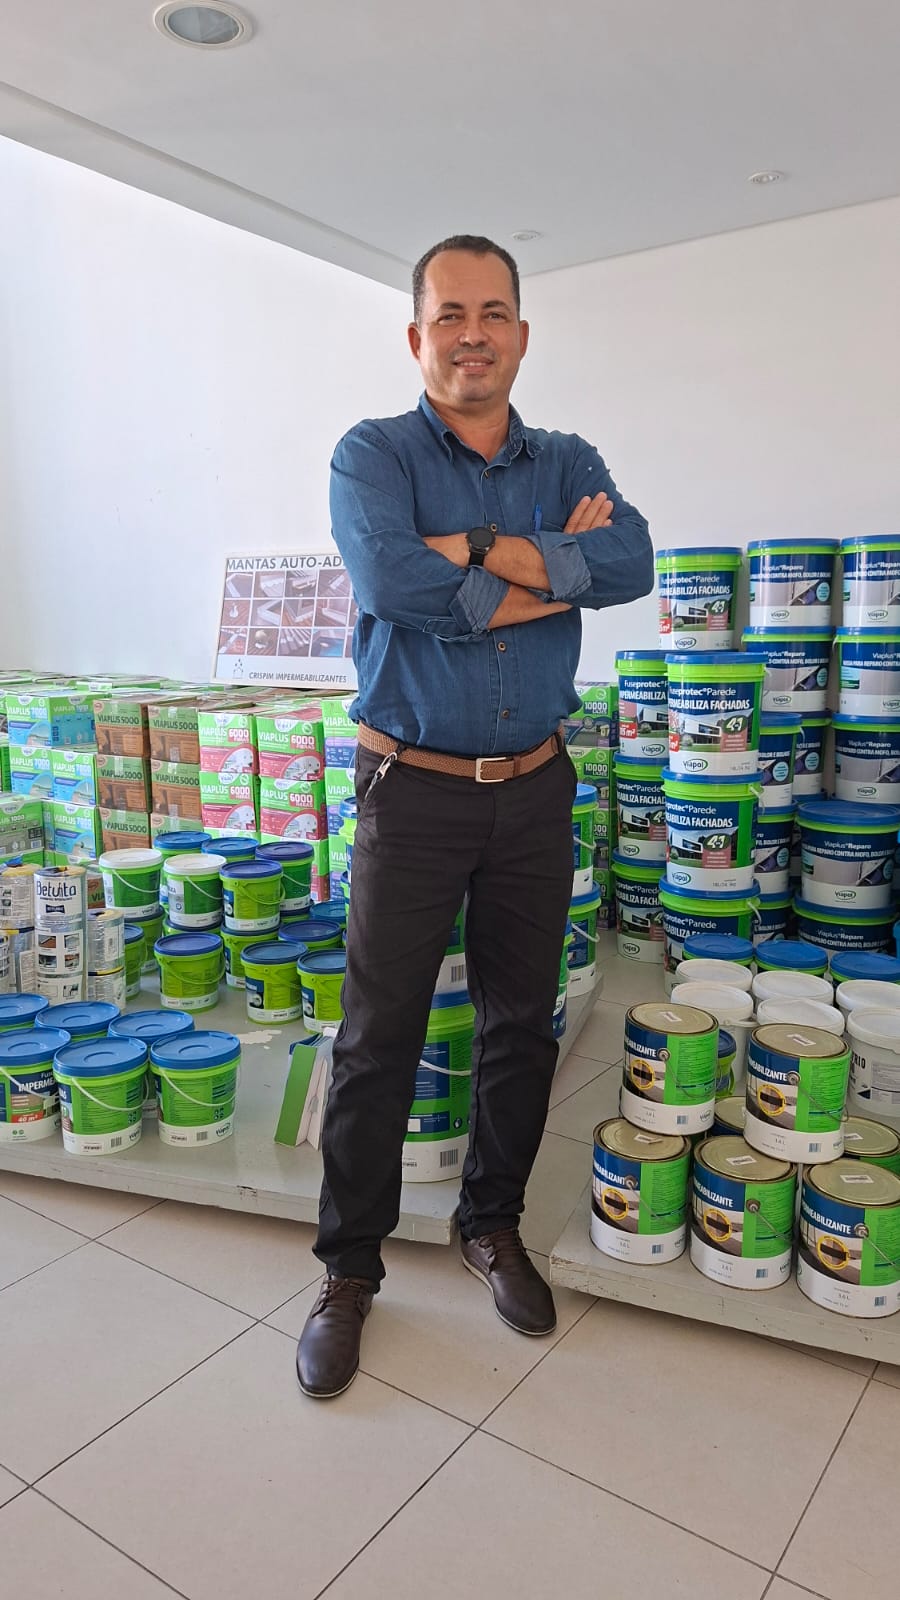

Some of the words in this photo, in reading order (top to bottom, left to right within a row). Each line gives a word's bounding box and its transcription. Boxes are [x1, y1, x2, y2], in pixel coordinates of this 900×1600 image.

[227, 558, 276, 570] MANTAS
[280, 555, 343, 569] AUTO-AD
[696, 575, 720, 584] Parede
[699, 585, 731, 595] FACHADAS
[249, 672, 275, 680] CRISPIM
[276, 672, 348, 683] IMPERMEABILIZANTES
[706, 688, 737, 697] Parede
[710, 699, 750, 710] FACHADAS
[97, 714, 120, 724] VIAPLUS
[120, 716, 140, 725] 5000
[323, 716, 355, 727] VIAPLU
[153, 720, 179, 730] VIAPLUS
[179, 721, 199, 731] 5000
[200, 727, 227, 738] VIAPLUS
[228, 728, 249, 738] 6000
[258, 731, 289, 744] VIAPLUS
[290, 735, 315, 746] 6000
[641, 745, 661, 754] Viapol
[683, 760, 704, 770] Viapol
[124, 770, 143, 780] 5000
[155, 774, 180, 784] VIAPLUS
[180, 776, 200, 786] 5000
[200, 784, 228, 795] VIAPLUS
[230, 786, 250, 796] 6000
[637, 784, 661, 793] Parede
[260, 788, 288, 801] VIAPLUS
[289, 793, 313, 804] 6000
[639, 795, 667, 805] FACHAD
[688, 804, 717, 815] Parede
[691, 817, 733, 829] FACHADAS
[129, 824, 147, 834] 5000
[637, 884, 659, 895] Pared
[688, 917, 717, 929] Parede
